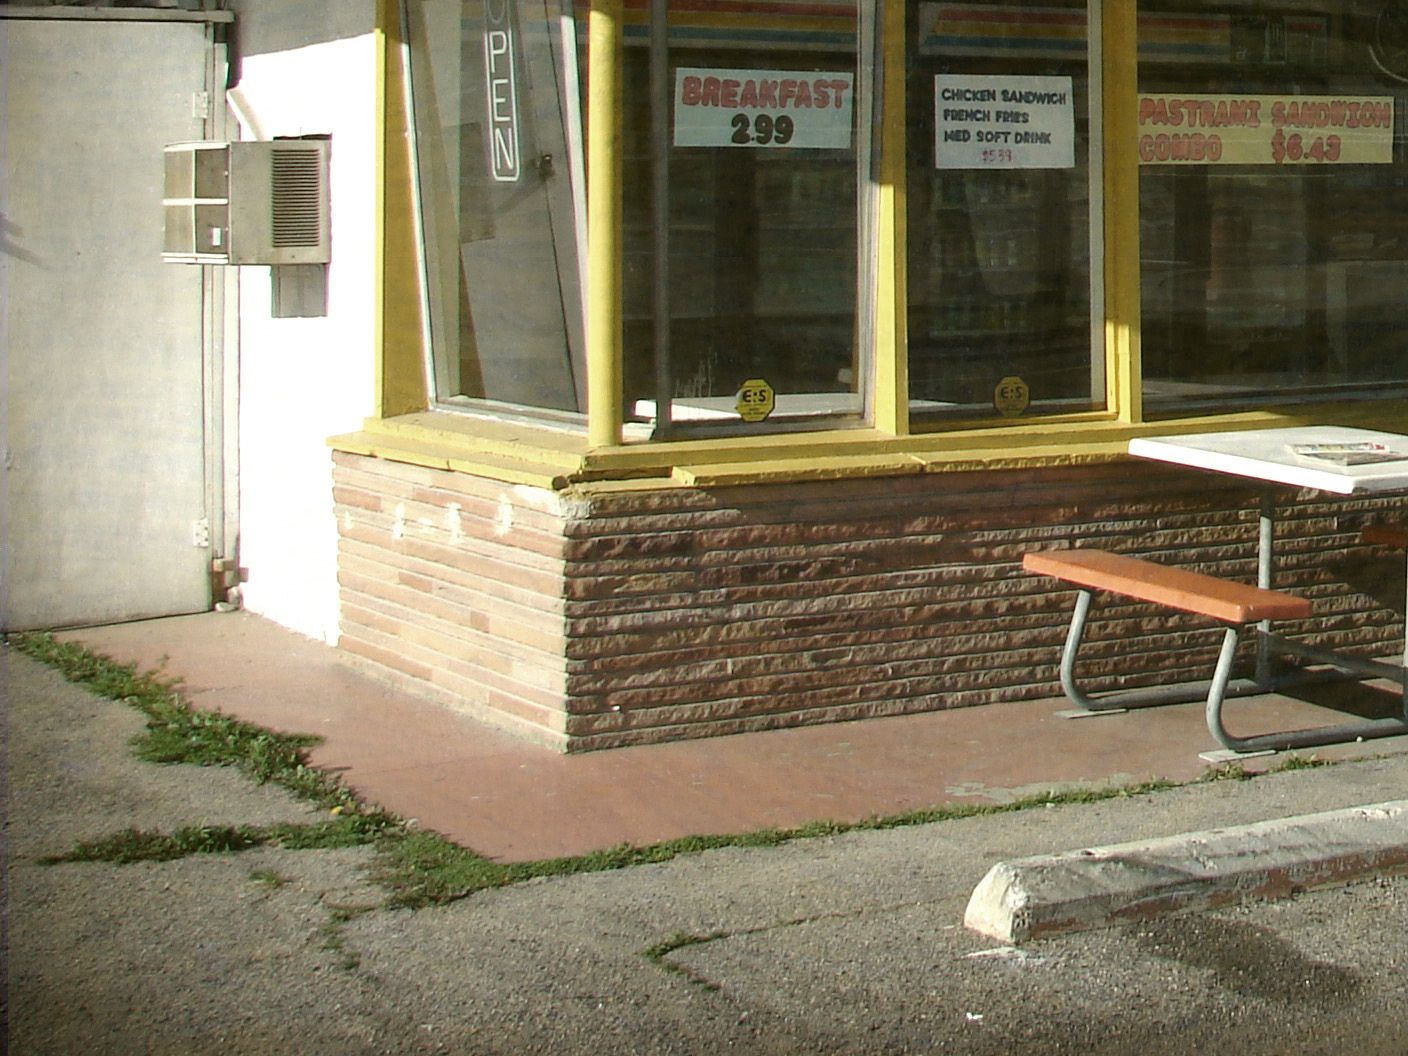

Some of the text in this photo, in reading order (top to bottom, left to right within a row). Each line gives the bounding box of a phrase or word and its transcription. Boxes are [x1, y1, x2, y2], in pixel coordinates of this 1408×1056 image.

[682, 76, 849, 109] BREAKFAST
[941, 88, 1067, 105] CHICKEN SANDWICH
[943, 108, 1030, 124] FRENCH FRIES
[1139, 97, 1390, 129] PASTRAMI SANDWICH
[731, 113, 794, 144] 2.99
[976, 130, 1012, 143] SOFT
[1014, 132, 1052, 145] DRINK
[1139, 133, 1223, 162] COMBO
